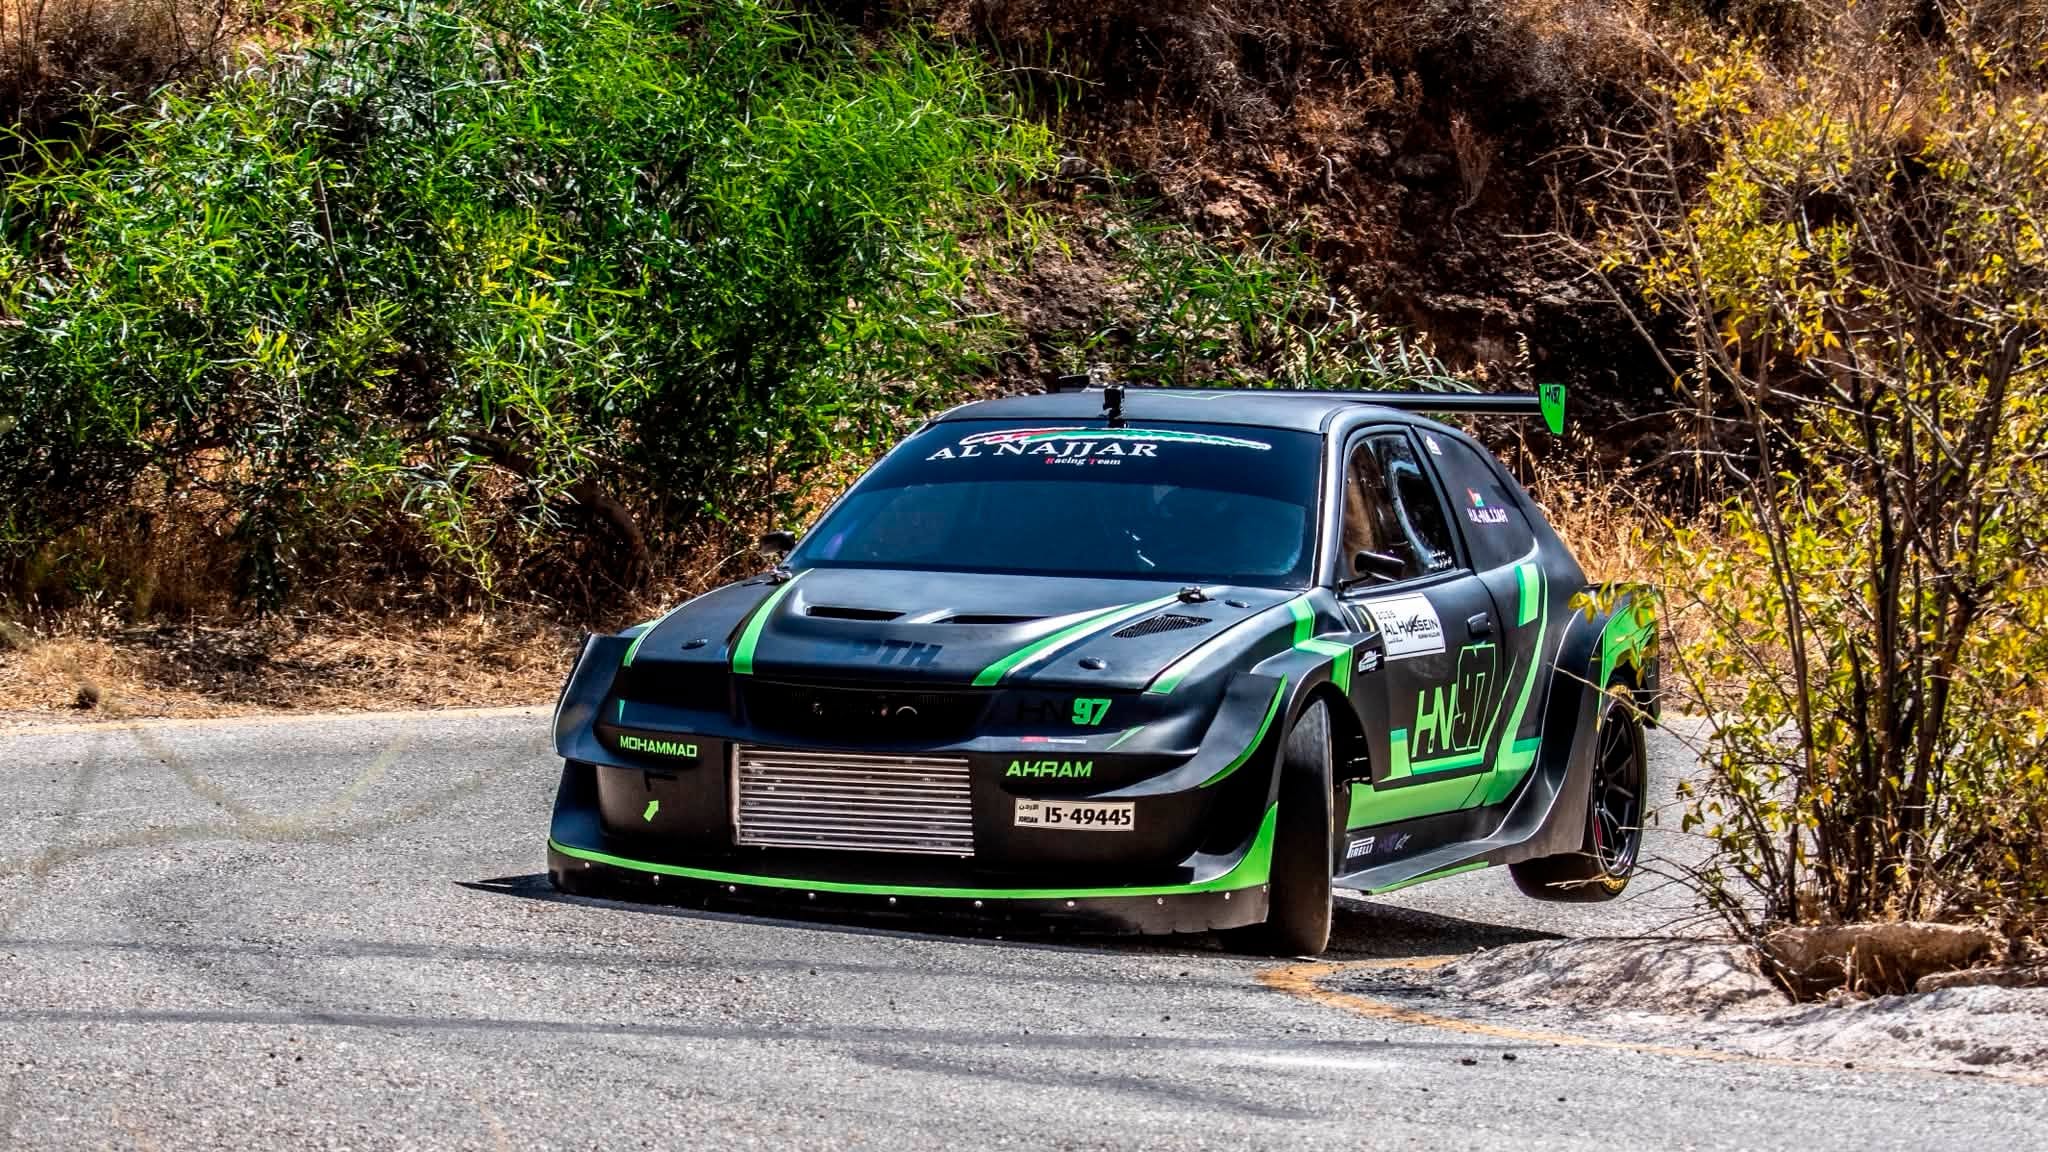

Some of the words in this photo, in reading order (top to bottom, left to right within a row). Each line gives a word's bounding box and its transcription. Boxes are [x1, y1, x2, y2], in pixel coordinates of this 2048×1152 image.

[925, 445, 982, 461] AL
[993, 441, 1158, 458] NAJJAR
[1045, 456, 1087, 466] Racing
[1089, 457, 1121, 466] Team
[1383, 622, 1399, 636] AL
[1397, 616, 1438, 634] HUSSEIN
[1412, 643, 1496, 759] HN97
[619, 735, 698, 758] MOHAMMAD
[1005, 760, 1094, 778] AKRAM
[1044, 805, 1132, 826] 15-49445
[1346, 836, 1376, 859] PIRELLI
